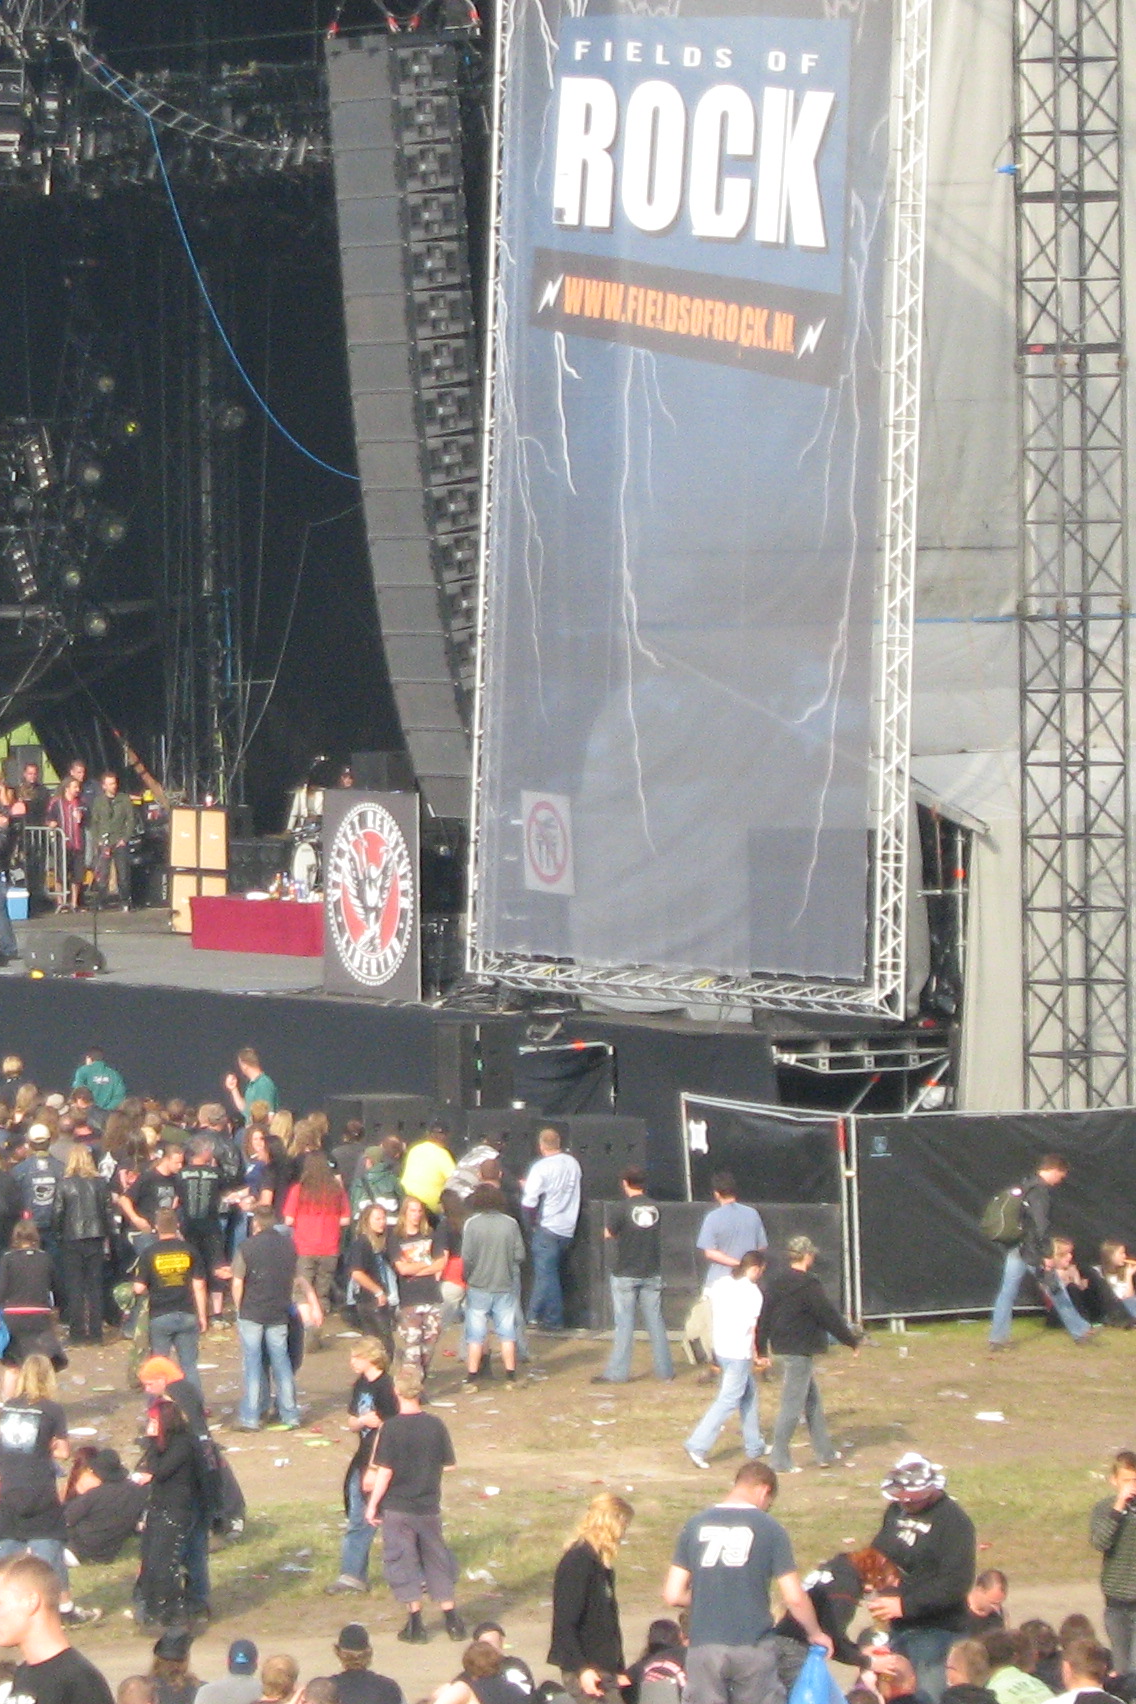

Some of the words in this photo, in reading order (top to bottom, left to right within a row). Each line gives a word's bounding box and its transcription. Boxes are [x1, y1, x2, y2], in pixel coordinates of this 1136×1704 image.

[574, 40, 733, 69] FIELDS
[768, 50, 820, 74] OF
[552, 76, 836, 249] ROCK
[341, 932, 402, 976] LIBERTAD
